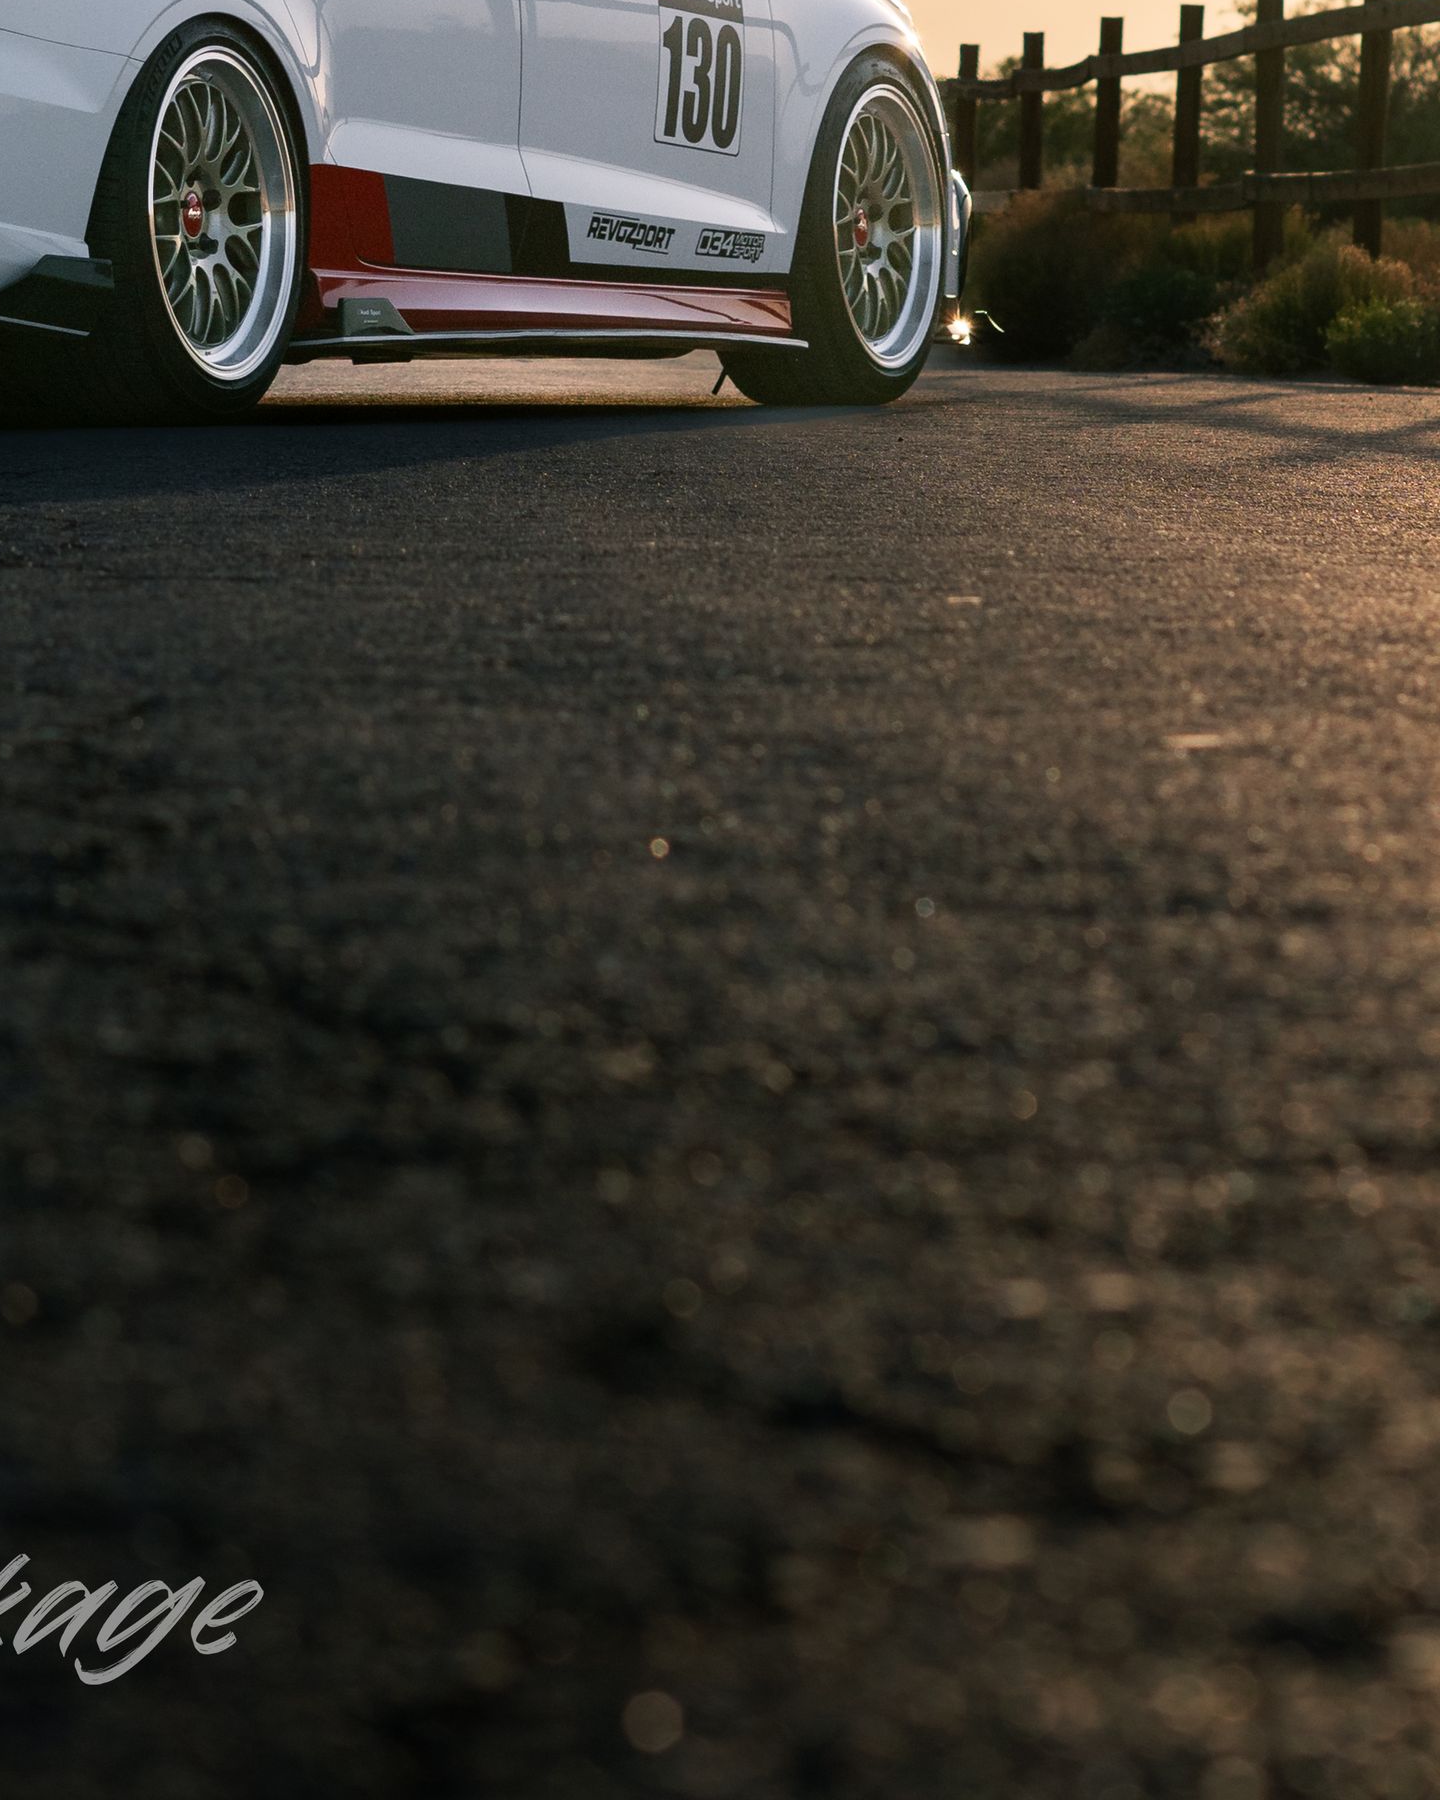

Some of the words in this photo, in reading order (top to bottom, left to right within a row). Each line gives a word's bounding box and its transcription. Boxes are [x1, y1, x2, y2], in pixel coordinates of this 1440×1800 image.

[663, 15, 742, 149] 130
[696, 230, 735, 257] 034
[734, 233, 765, 247] MOTOR
[734, 245, 763, 263] SPORT
